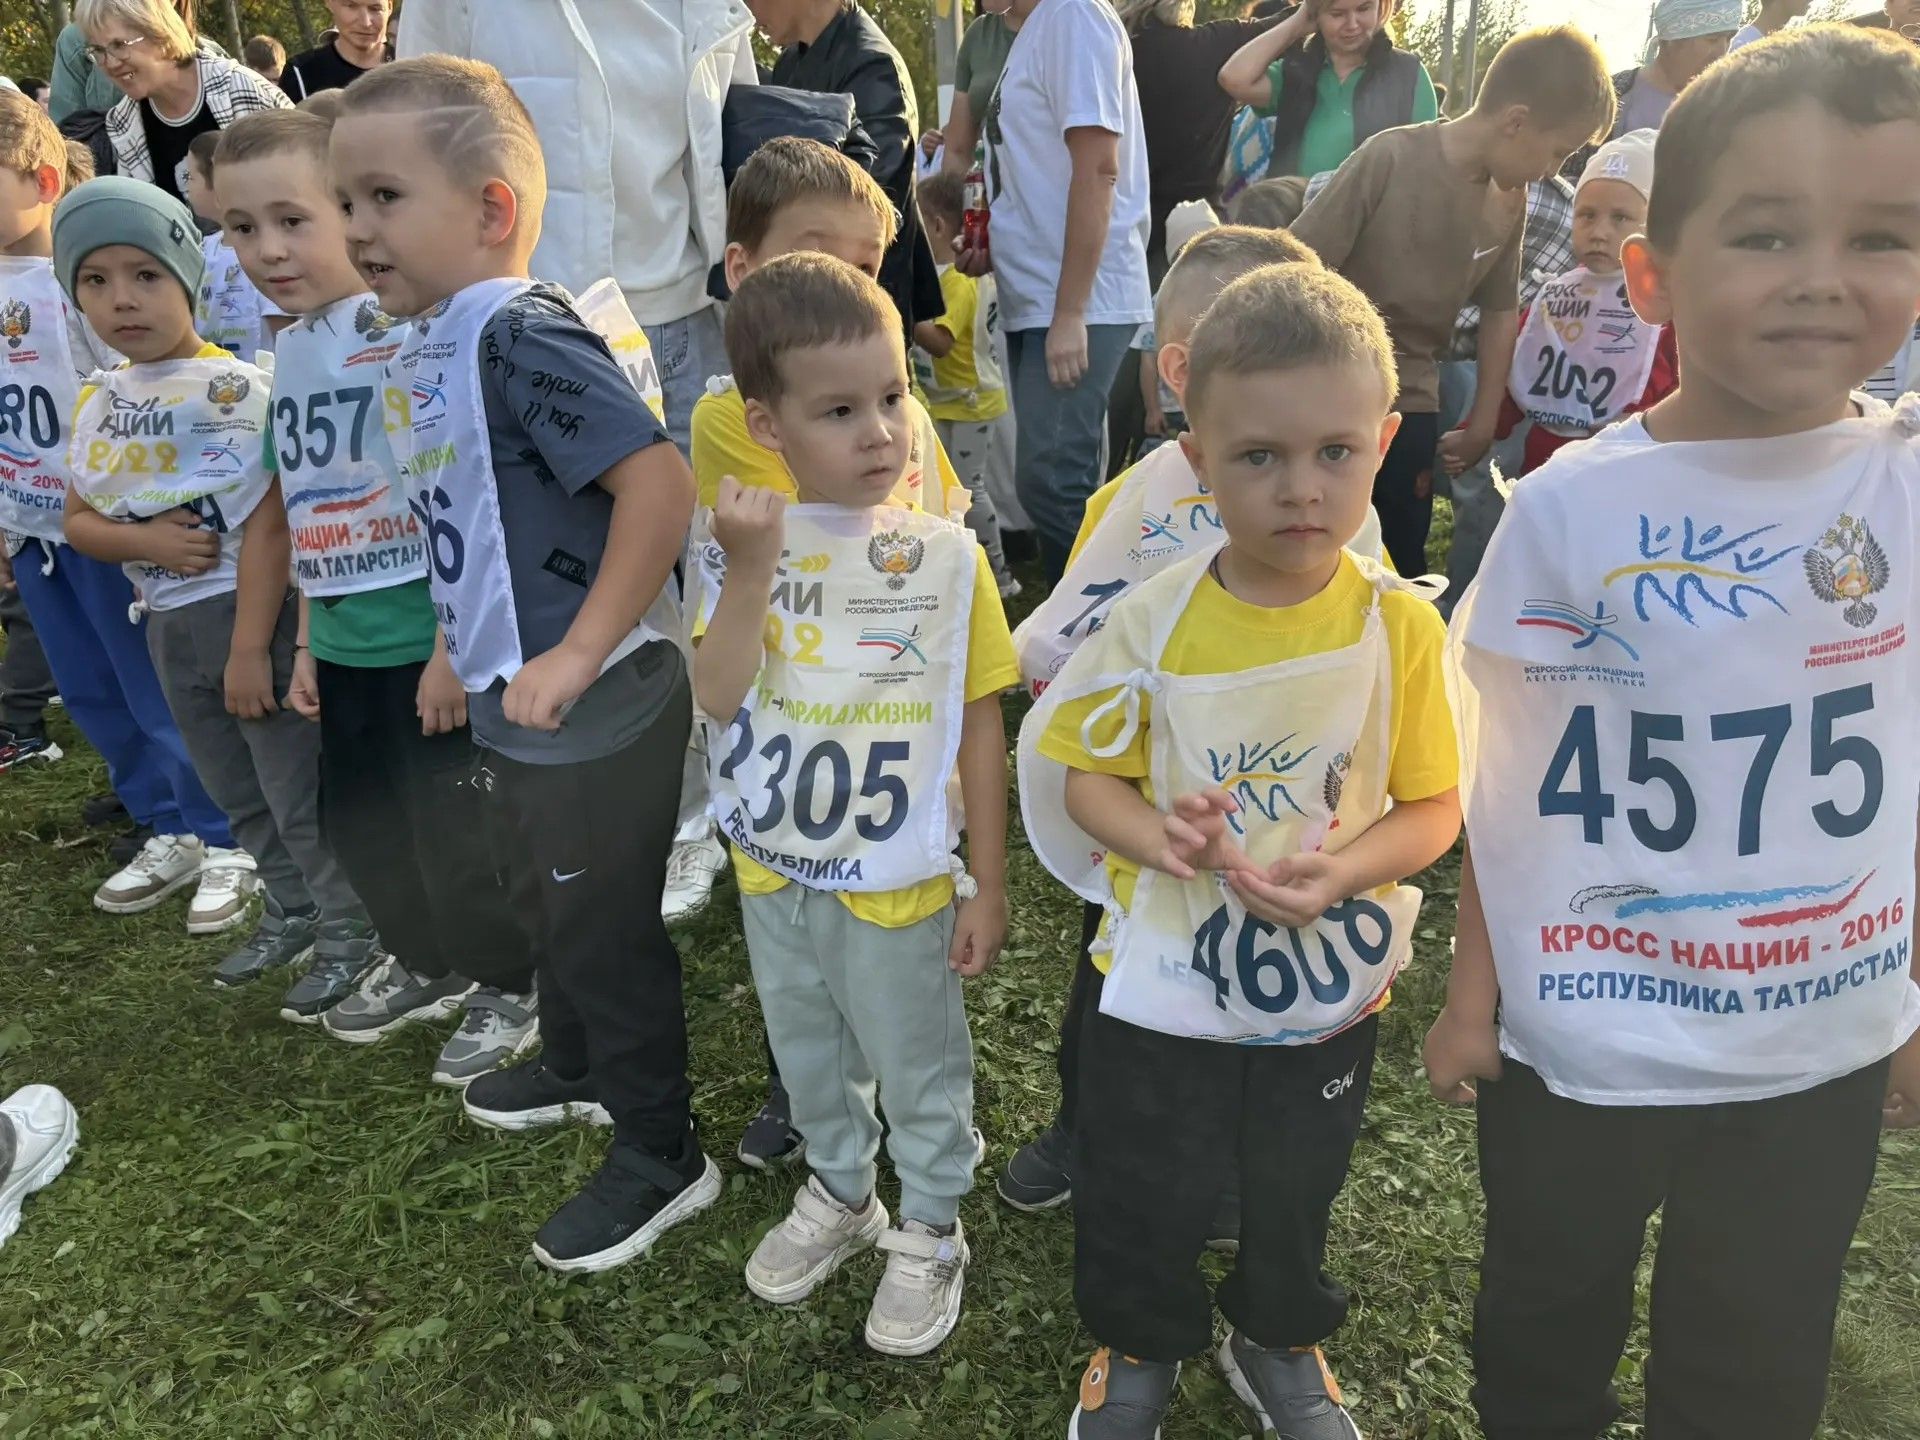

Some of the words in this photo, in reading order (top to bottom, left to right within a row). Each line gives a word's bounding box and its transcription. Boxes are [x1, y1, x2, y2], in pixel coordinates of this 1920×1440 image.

[269, 385, 374, 472] 357
[323, 543, 422, 577] ТАТАРСТАН
[368, 512, 419, 542] 2014
[1524, 664, 1601, 674] ВСЕРОССИЙСКАЯ
[1525, 672, 1577, 682] ЛЕГКОЙ
[850, 701, 932, 724] ЖИЗНИ
[719, 705, 910, 842] 2305
[1538, 682, 1884, 857] 4575
[725, 807, 863, 881] РЕСПУБЛИКА
[1191, 896, 1393, 1014] 4608
[1541, 924, 1660, 959] КРОСС
[1670, 936, 1810, 975] НАЦИИ
[1840, 897, 1903, 950] 2016
[1539, 971, 1744, 1014] РЕСПУБЛИКА
[1754, 936, 1908, 1011] ТАТАРСТАН
